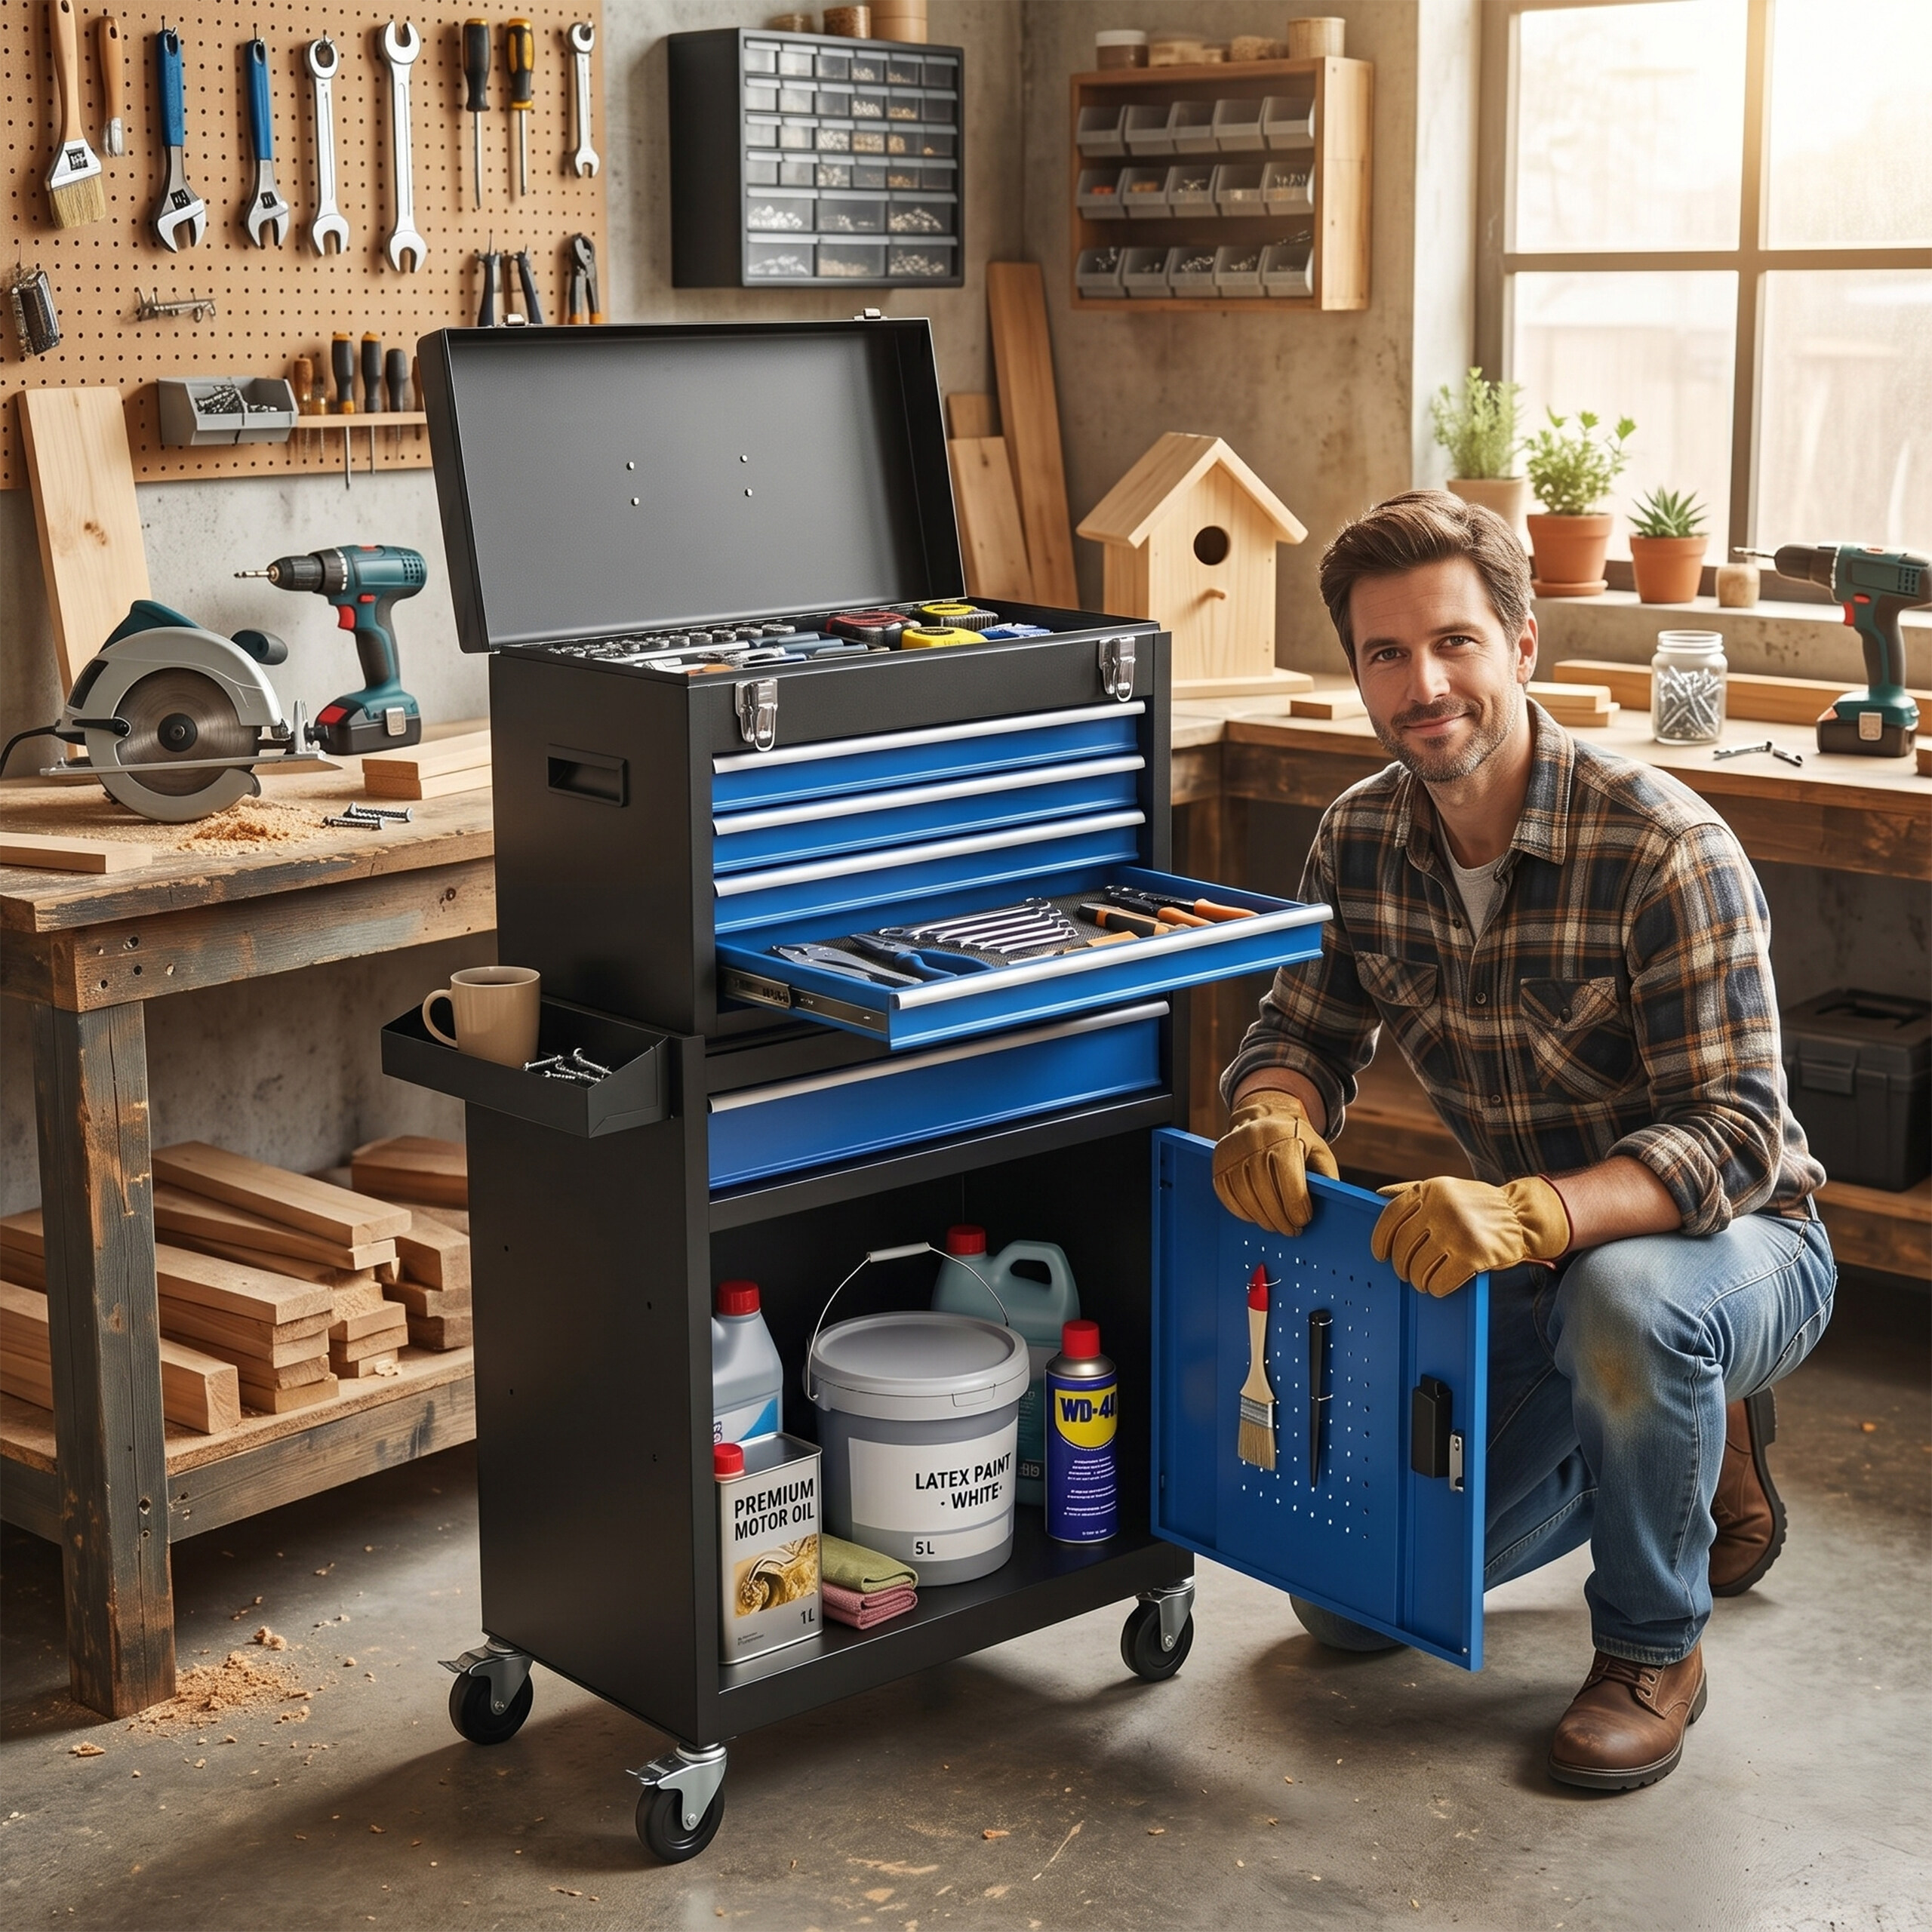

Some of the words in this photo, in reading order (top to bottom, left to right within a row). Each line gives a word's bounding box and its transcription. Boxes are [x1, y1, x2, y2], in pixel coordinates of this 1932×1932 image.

[915, 1469, 970, 1490] LATEX
[974, 1452, 1011, 1482] PAINT
[734, 1478, 814, 1518] PREMIUM
[735, 1509, 787, 1541] MOTOR
[792, 1502, 815, 1523] OIL
